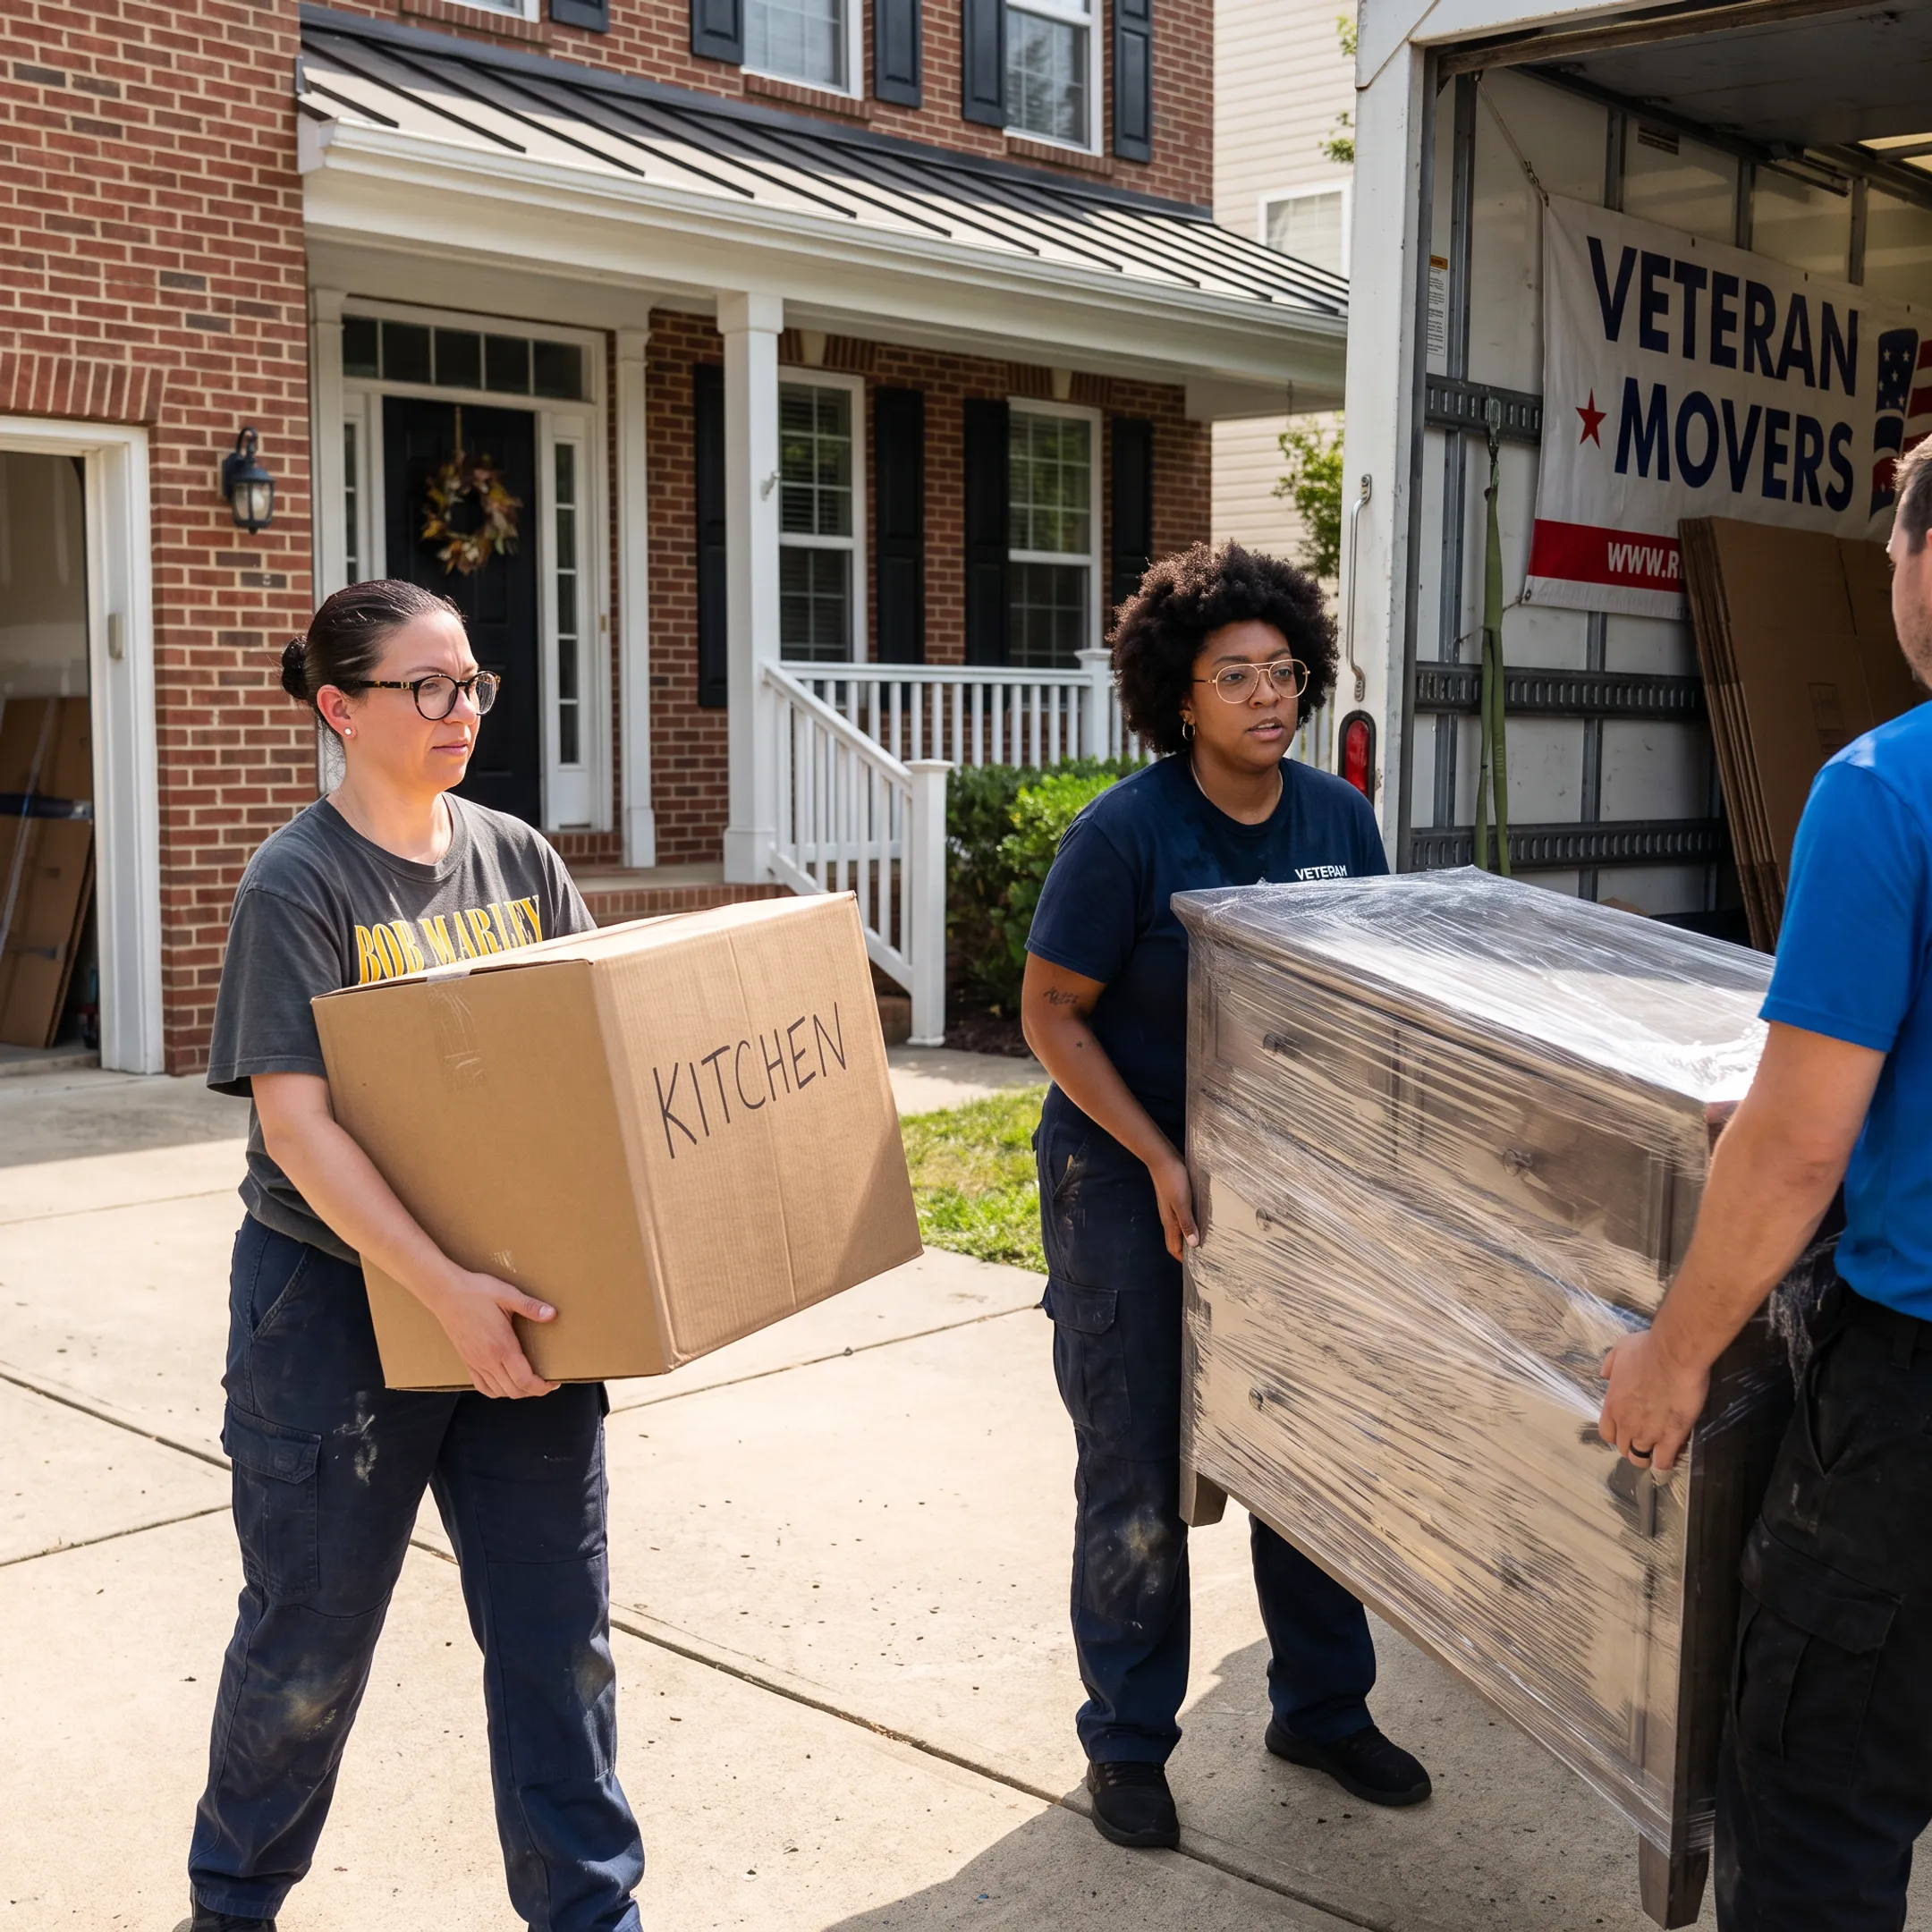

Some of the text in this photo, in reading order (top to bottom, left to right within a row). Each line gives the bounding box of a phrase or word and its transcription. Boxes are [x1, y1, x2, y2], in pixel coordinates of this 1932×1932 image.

[1587, 235, 1859, 397] VETERAN
[1614, 377, 1853, 513] MOVERS
[1607, 541, 1685, 579] WWW.R
[354, 894, 543, 985] BOB MARLEY
[653, 1002, 846, 1159] KITCHEN
